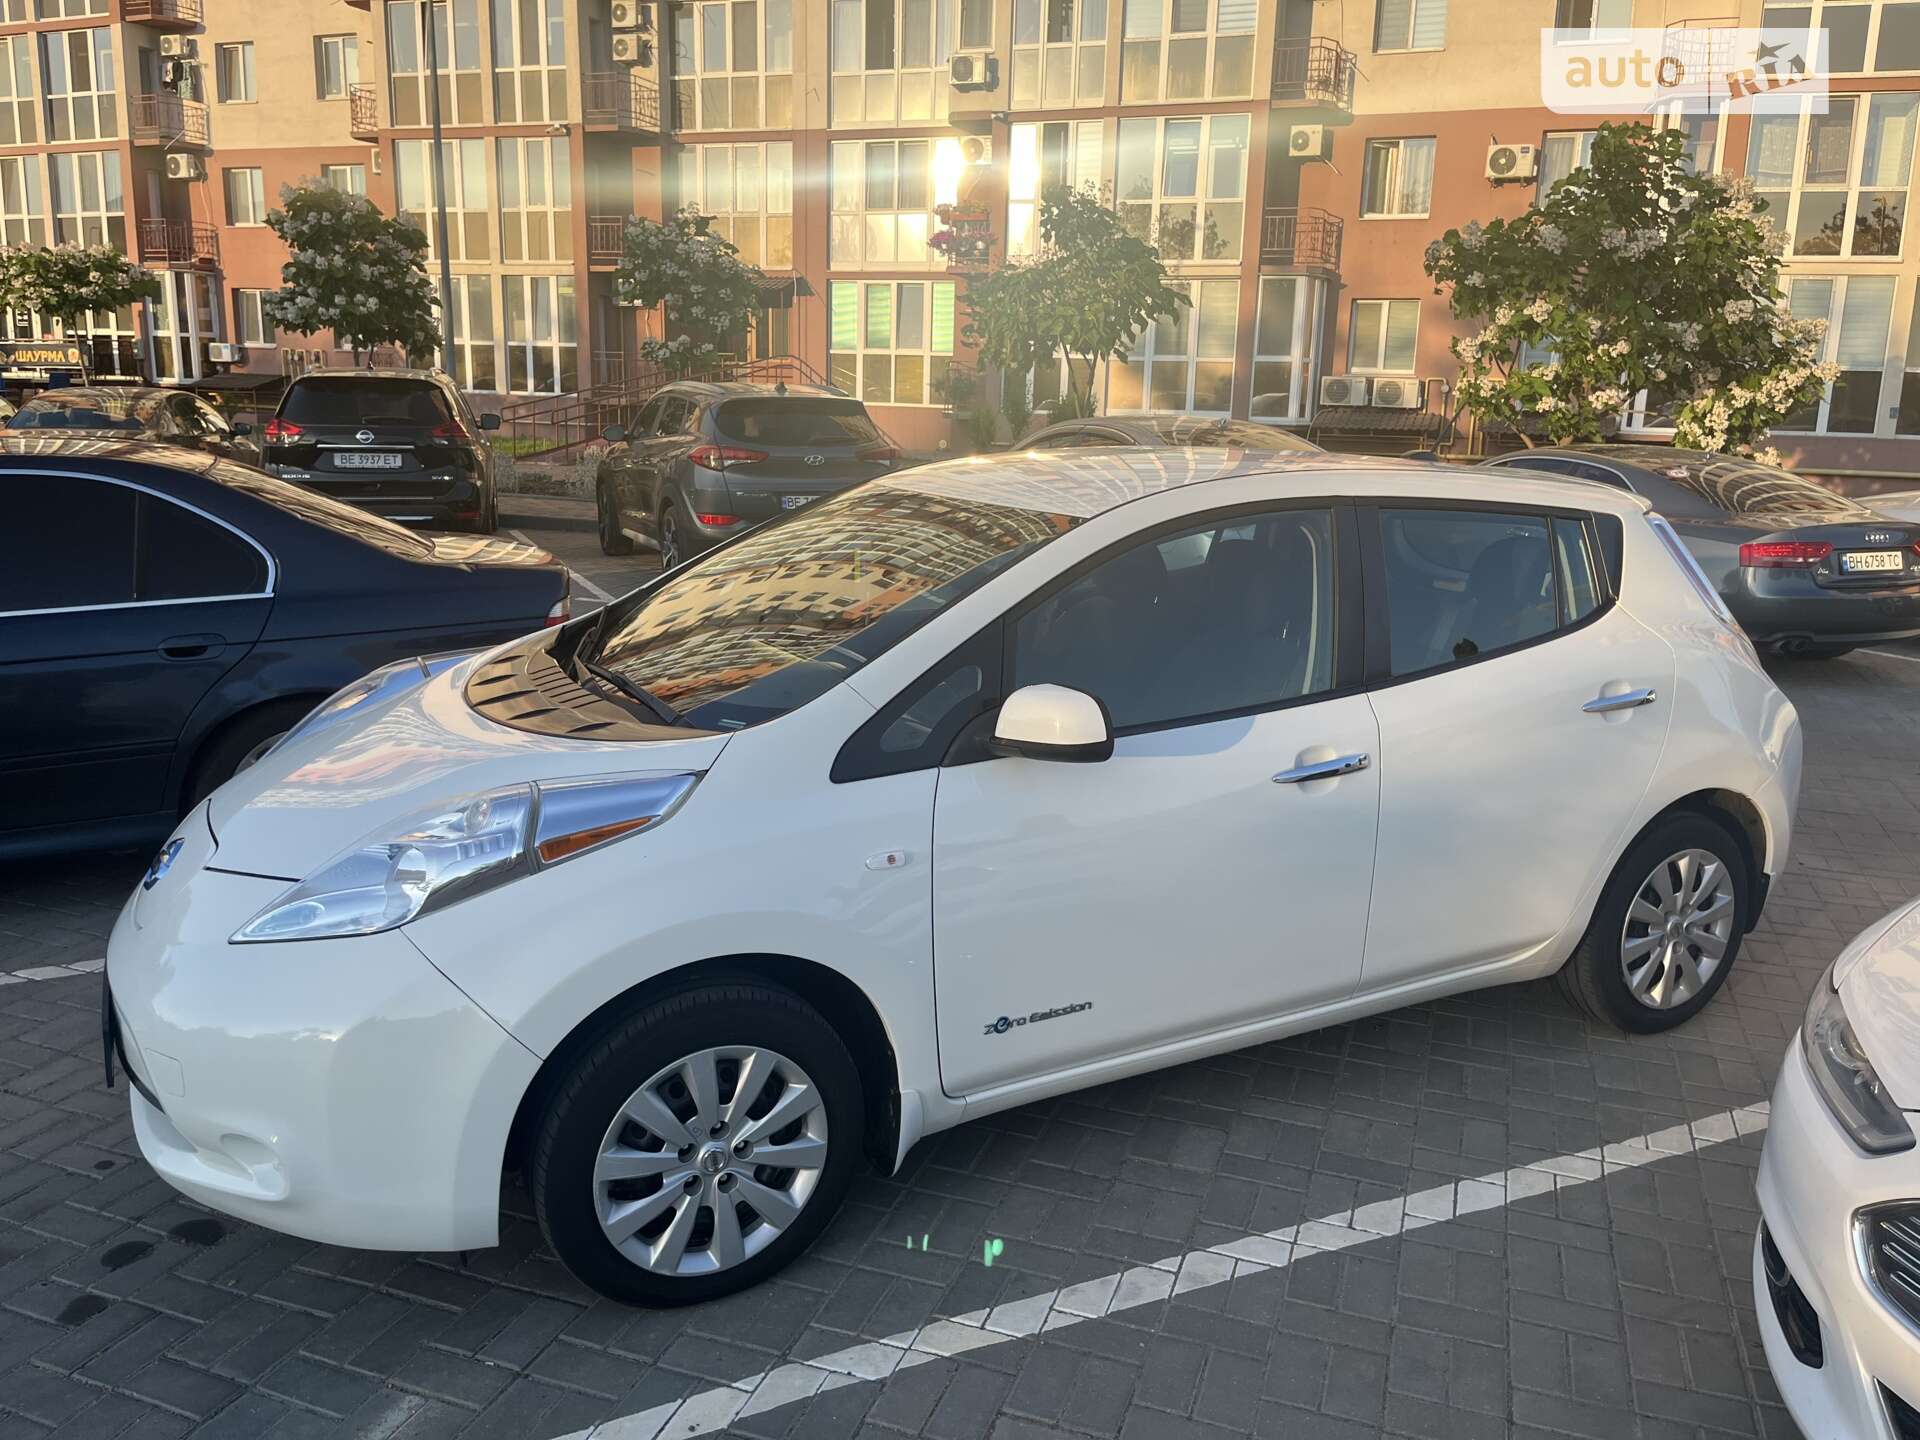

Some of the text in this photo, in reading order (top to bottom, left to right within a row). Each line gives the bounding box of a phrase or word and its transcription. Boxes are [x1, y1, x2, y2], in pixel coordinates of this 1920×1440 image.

[15, 350, 66, 363] ШАУРМА
[340, 454, 399, 465] BE 3937 ET
[1848, 554, 1900, 569] BH 6758 TC
